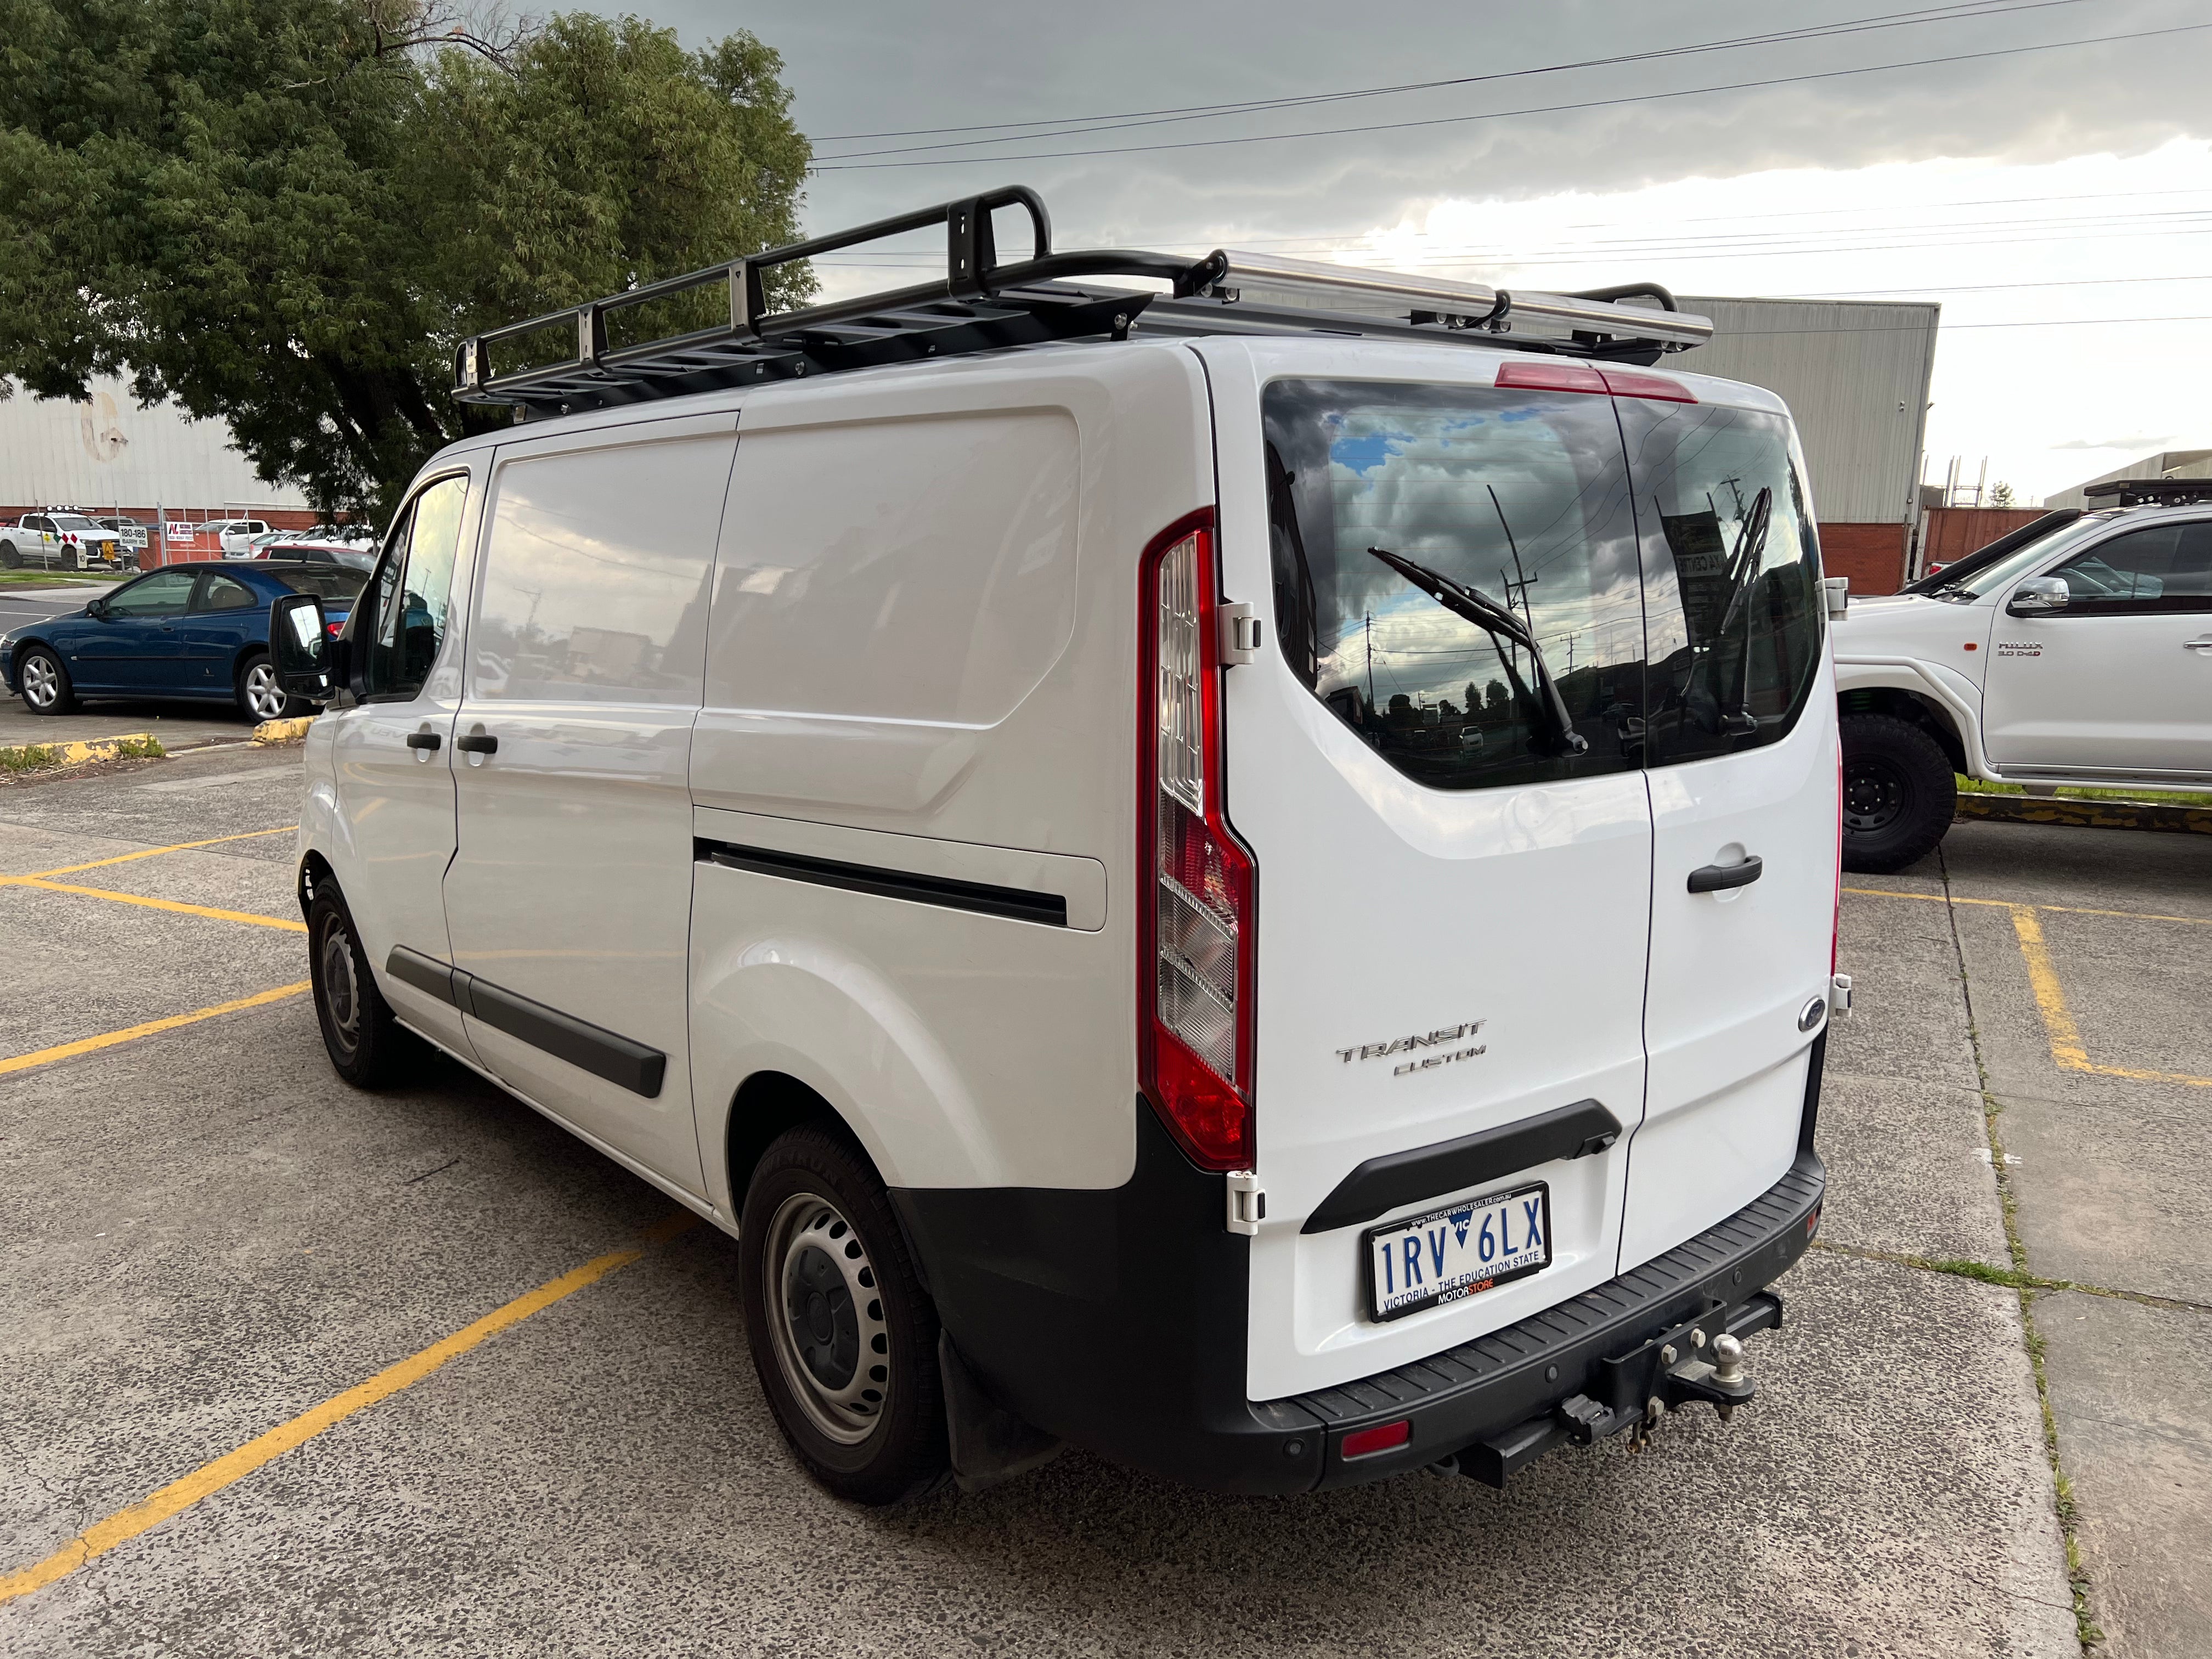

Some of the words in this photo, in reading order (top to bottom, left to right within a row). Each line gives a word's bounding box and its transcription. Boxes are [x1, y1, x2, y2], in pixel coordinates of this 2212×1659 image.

[121, 528, 145, 538] 180-186
[1336, 1018, 1487, 1063] TRANSIT
[1394, 1044, 1487, 1076] CUSTOM
[1453, 1219, 1470, 1233] VIC
[1384, 1287, 1429, 1311] VICTORIA
[1438, 1277, 1456, 1292] THE
[1459, 1260, 1510, 1285] EDUCATION
[1513, 1251, 1539, 1267] STATE
